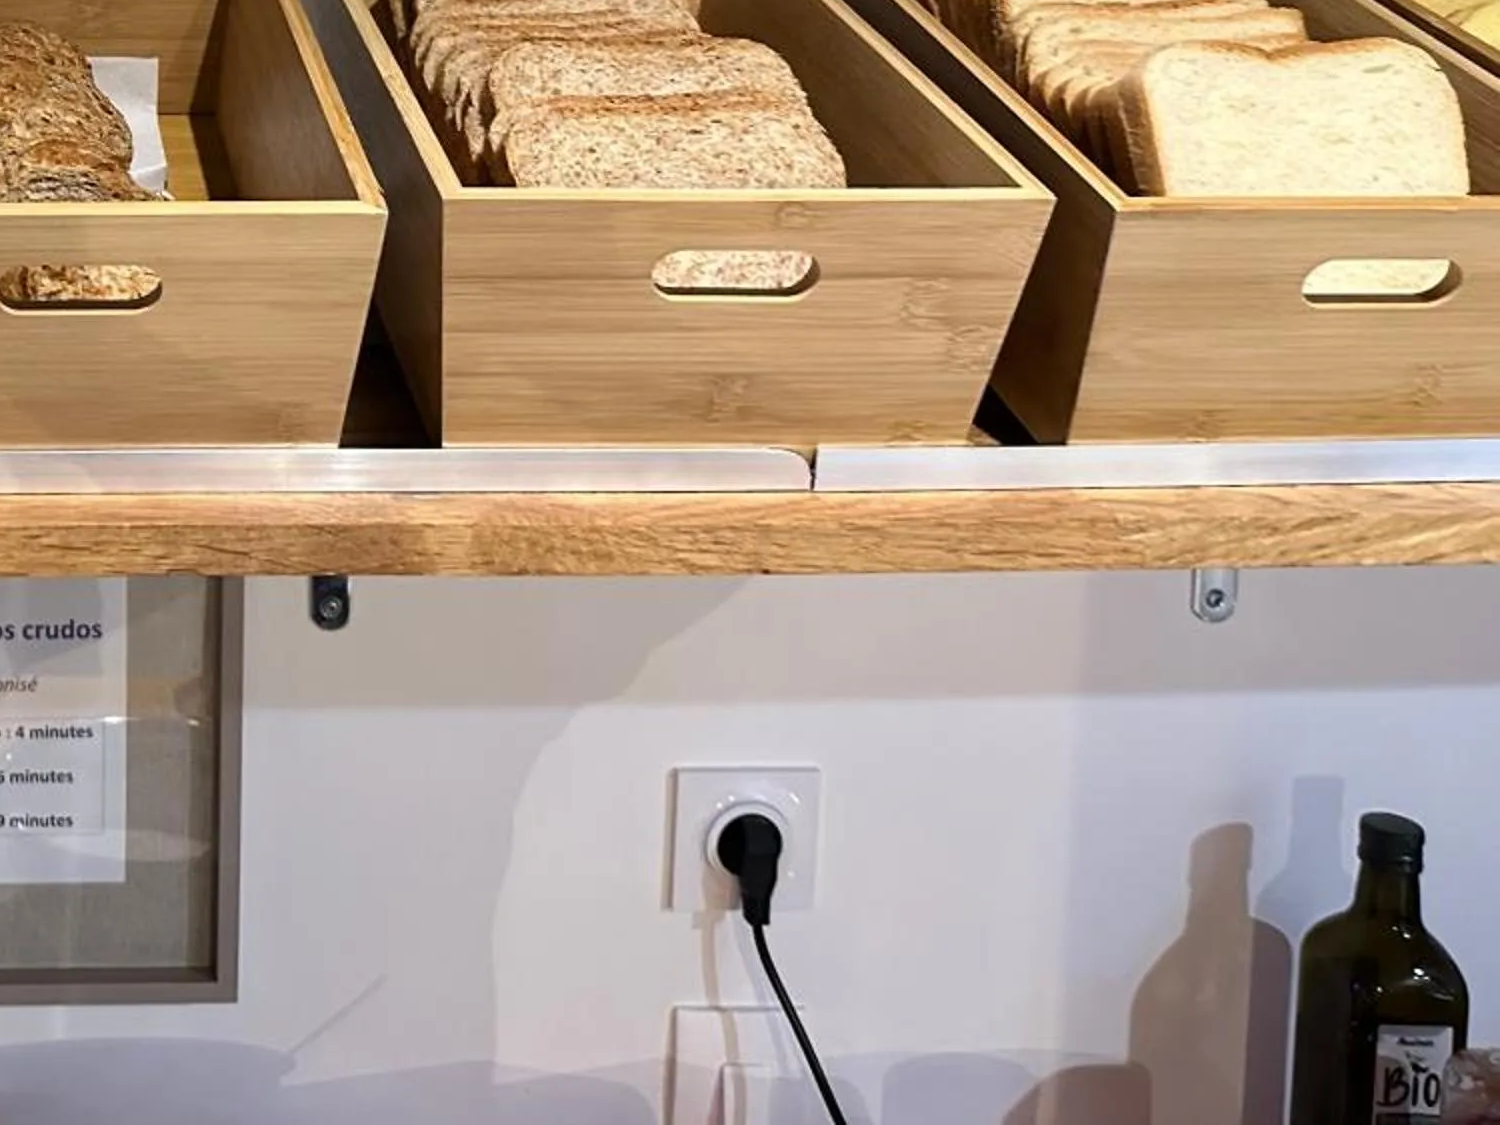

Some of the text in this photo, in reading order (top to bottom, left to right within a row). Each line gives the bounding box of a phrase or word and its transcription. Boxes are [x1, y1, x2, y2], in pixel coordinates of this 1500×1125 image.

[21, 618, 104, 641] crudos
[15, 725, 25, 739] 4
[29, 724, 94, 739] minutes
[9, 768, 74, 784] minutes
[9, 813, 74, 828] minutes
